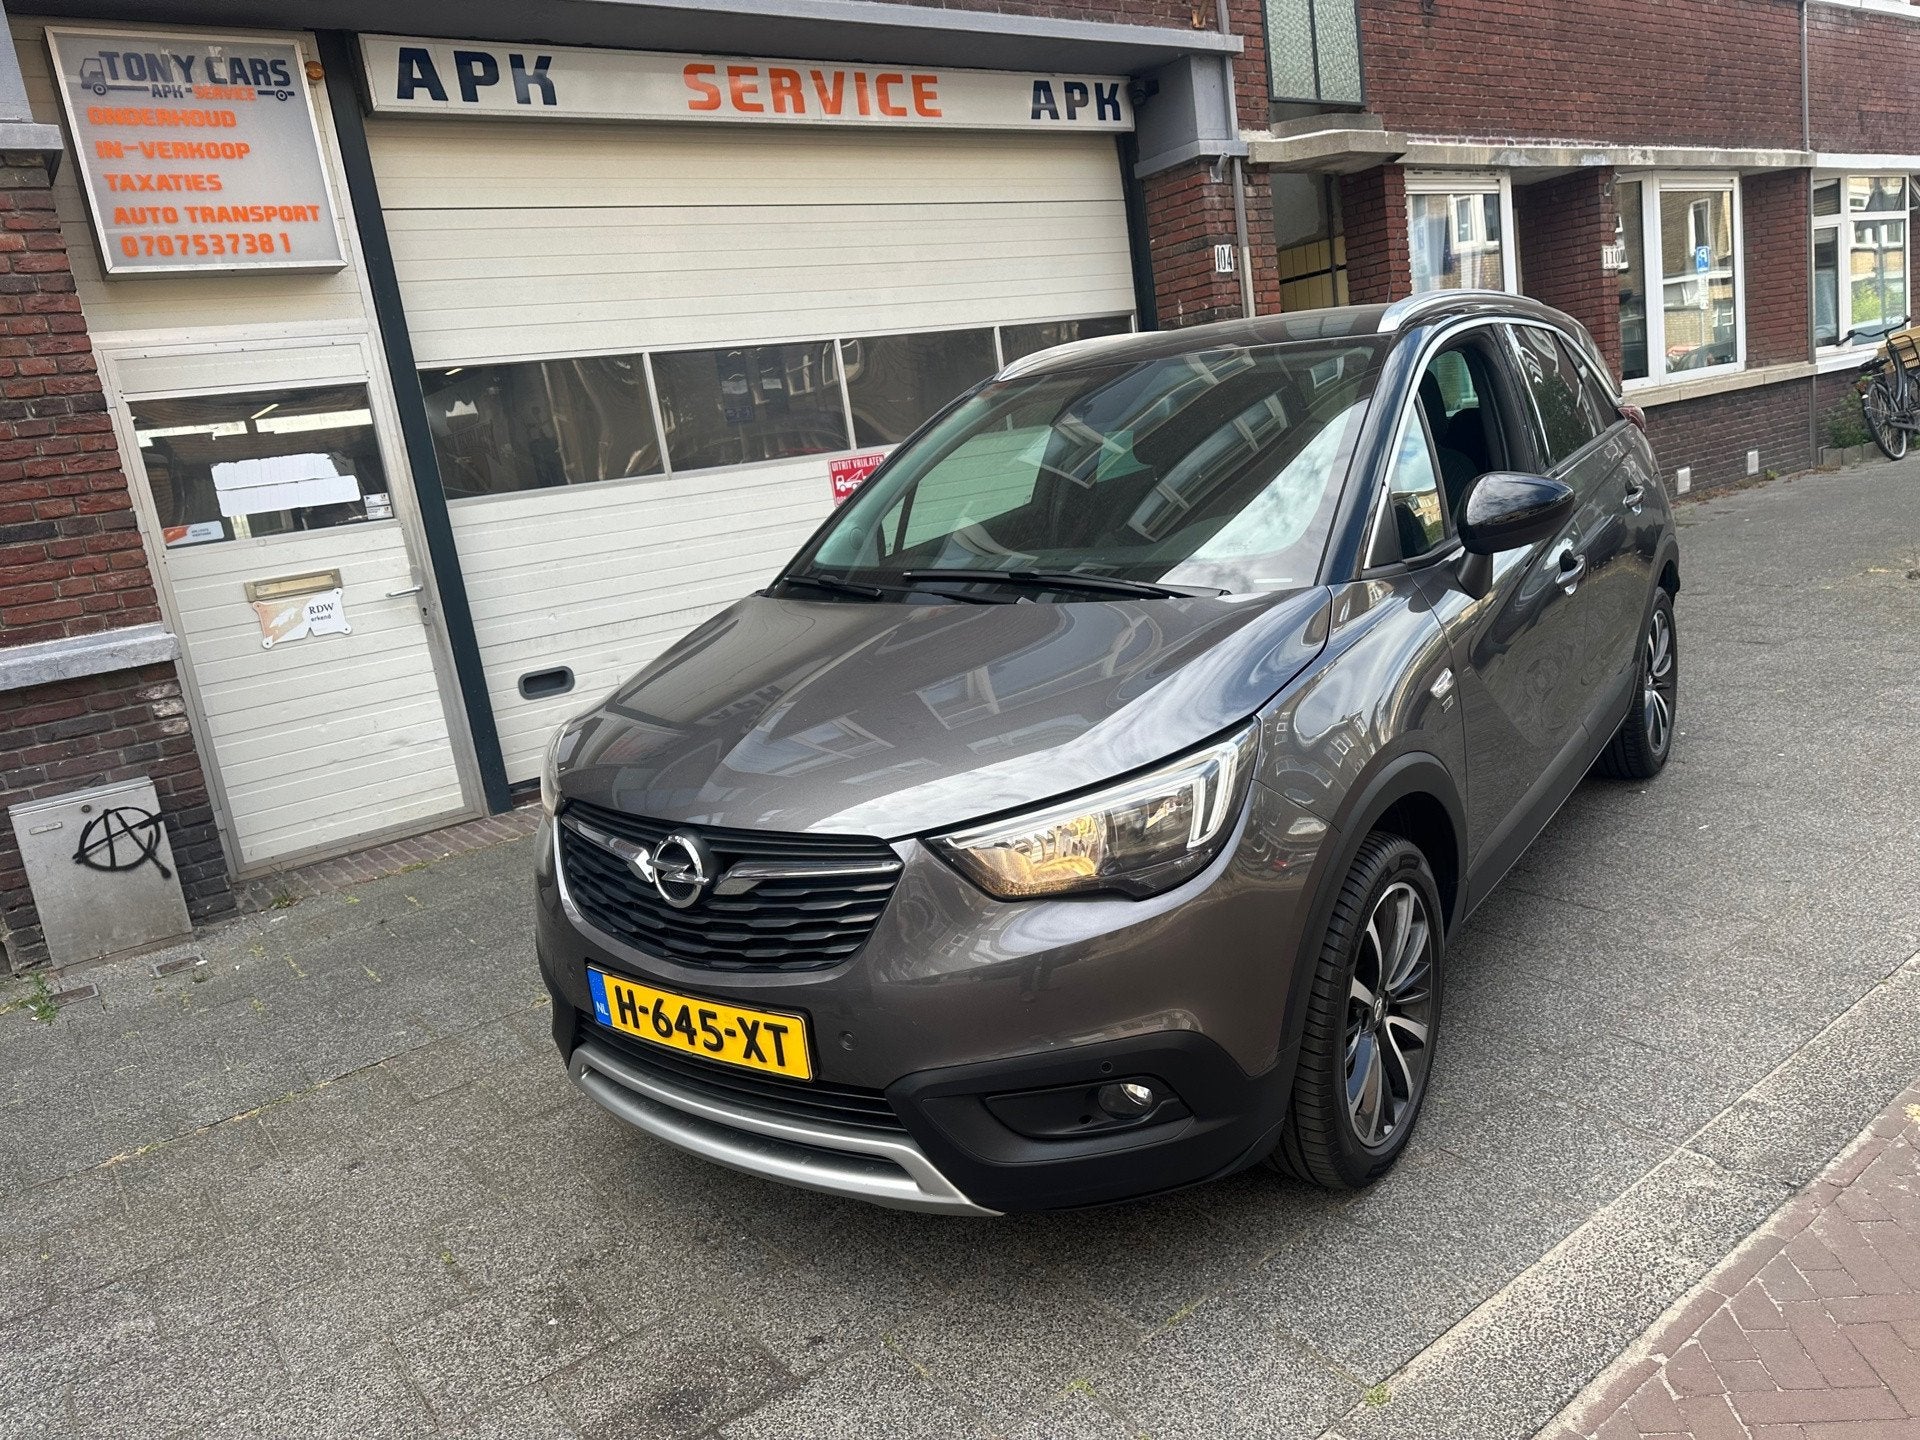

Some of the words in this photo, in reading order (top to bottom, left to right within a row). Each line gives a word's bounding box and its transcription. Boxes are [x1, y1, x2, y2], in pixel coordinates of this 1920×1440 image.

[99, 51, 195, 83] TONY
[205, 57, 291, 87] CARS
[397, 46, 557, 106] APK
[683, 63, 943, 118] SERVICE
[1030, 80, 1122, 122] APK
[87, 106, 237, 128] ONDERHOUD
[95, 140, 251, 160] IN-VERKOOP
[103, 173, 223, 192] TAXATIES
[113, 206, 179, 225] AUTO
[184, 205, 321, 223] TRANSPORT
[1216, 246, 1233, 270] 104
[1604, 250, 1621, 264] 110
[831, 460, 852, 472] UITRIT
[308, 602, 334, 615] RDW
[596, 1001, 609, 1016] NL
[615, 985, 788, 1067] H-645-XT
